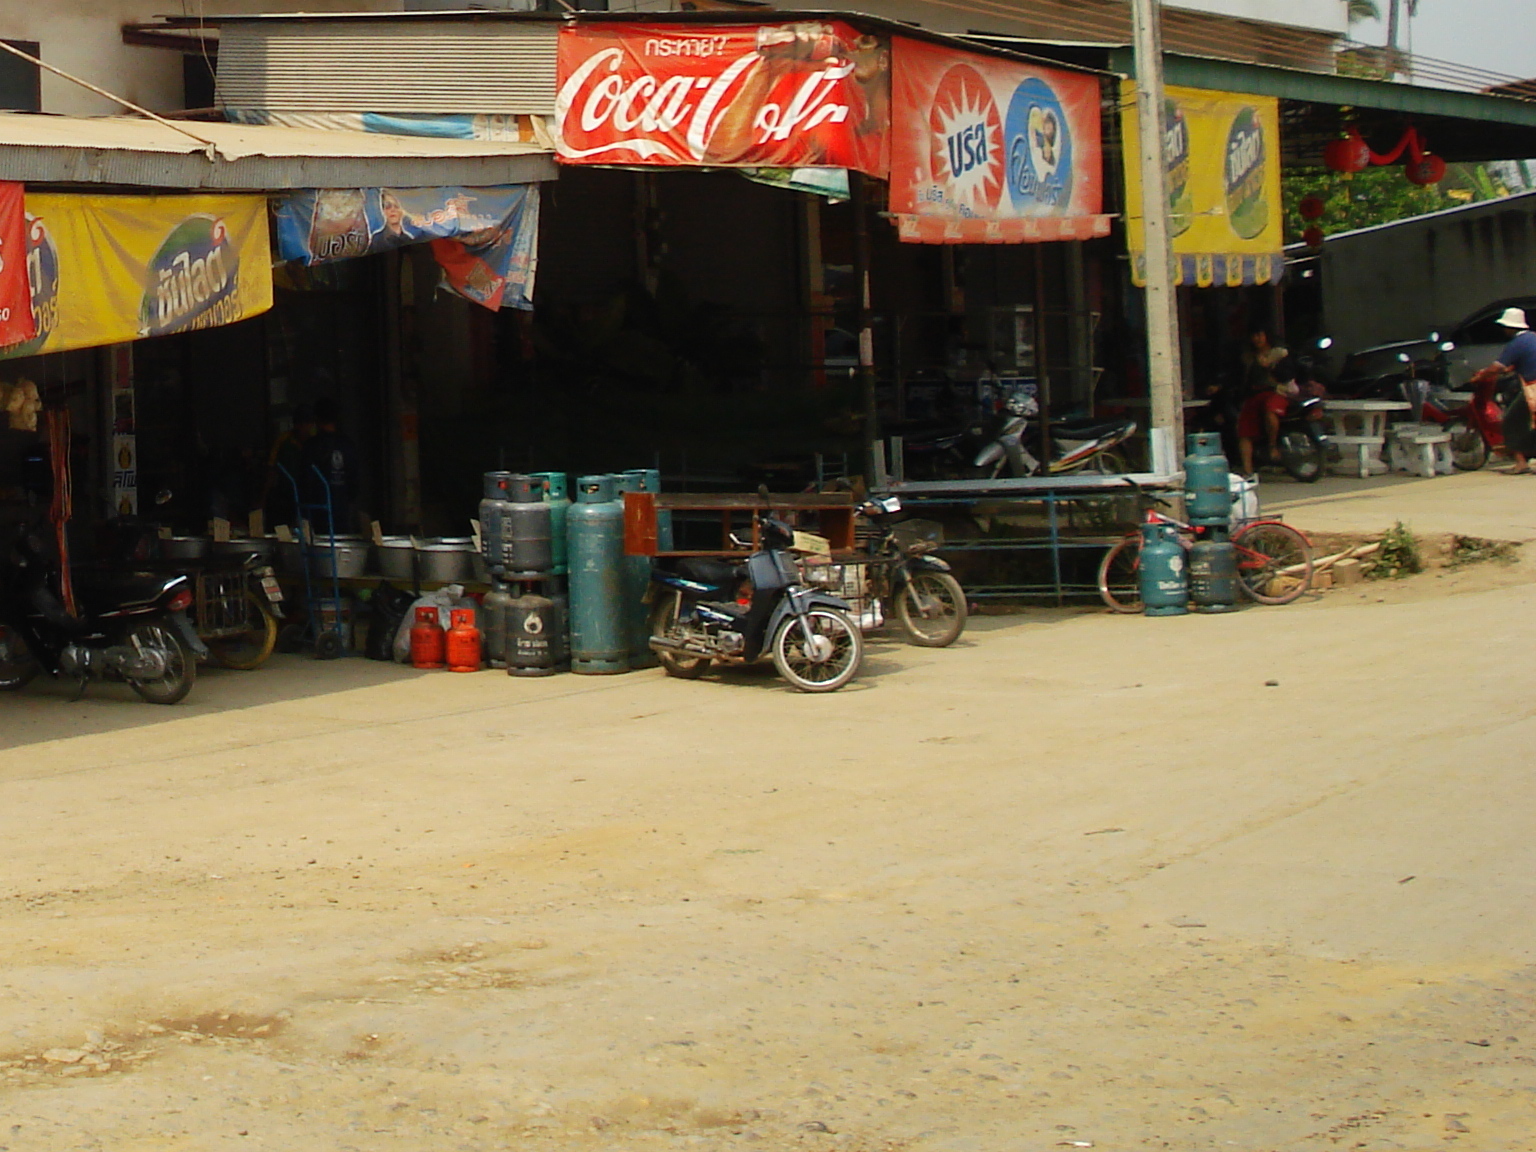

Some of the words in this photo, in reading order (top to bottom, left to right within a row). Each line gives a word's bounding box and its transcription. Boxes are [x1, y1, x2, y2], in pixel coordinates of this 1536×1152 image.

[644, 36, 727, 58] กระหาย?
[947, 121, 988, 178] บรีส
